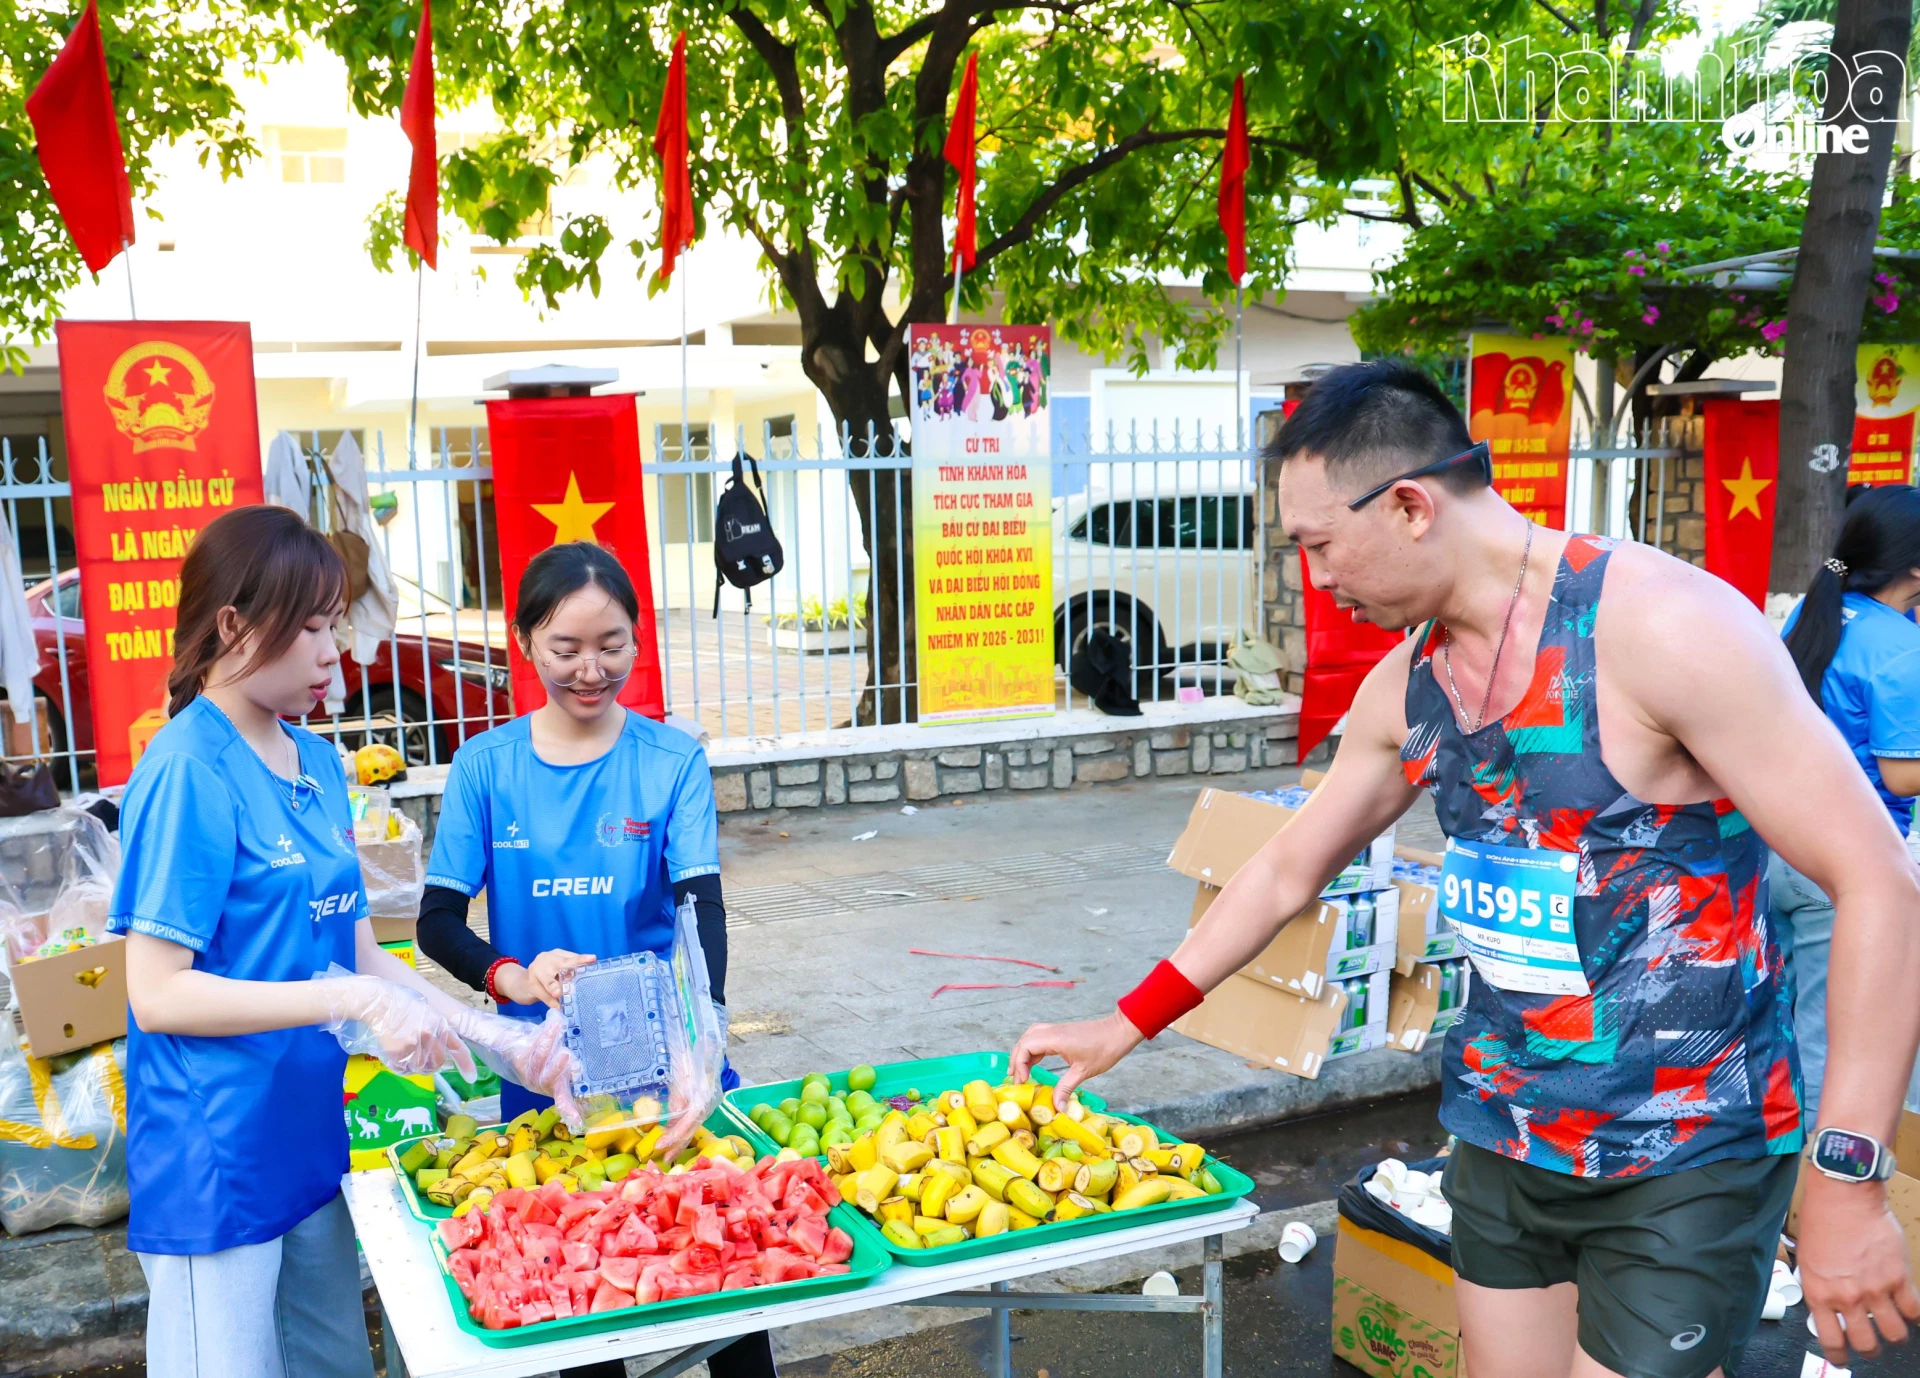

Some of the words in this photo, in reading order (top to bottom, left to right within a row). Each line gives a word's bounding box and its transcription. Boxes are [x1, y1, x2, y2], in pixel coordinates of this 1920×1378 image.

[966, 432, 980, 453] CỬ
[982, 438, 1000, 453] TRI
[939, 461, 964, 482] TỈNH
[967, 462, 1003, 481] KHÁNH
[102, 476, 158, 513] NGÀY
[162, 468, 204, 509] BẦU
[208, 469, 235, 507] CỬ
[934, 491, 957, 510] TÍCH
[960, 493, 980, 512] CỰC
[983, 493, 1013, 509] THAM
[1016, 492, 1033, 508] GIA
[942, 515, 963, 538] BẦU
[966, 516, 980, 537] CỬ
[982, 521, 1000, 539] ĐẠI
[1003, 513, 1026, 536] BIỂU
[111, 527, 139, 562] LÀ
[936, 544, 963, 569] QUỐC
[965, 546, 983, 568] HỘI
[1016, 547, 1033, 562] XVI
[929, 576, 943, 594] VÀ
[946, 578, 963, 596] ĐẠI
[966, 570, 990, 592] BIỂU
[993, 573, 1010, 594] HỘI
[1013, 570, 1040, 590] ĐỒNG
[108, 581, 146, 615] ĐẠI
[936, 602, 967, 622] NHÂN
[969, 601, 991, 620] DÂN
[994, 600, 1013, 618] CÁC
[1015, 597, 1035, 617] CẤP
[105, 625, 163, 661] TOÀN
[928, 630, 963, 652] NHIỆM
[982, 630, 1007, 647] 2026
[1016, 628, 1044, 645] 2031!
[425, 874, 472, 893] PIONSHIP
[532, 876, 614, 898] CREW
[1444, 873, 1543, 928] 91595
[1555, 902, 1563, 914] C
[132, 917, 204, 949] HAMPIONSHIP
[1486, 936, 1501, 945] KUPO
[1425, 940, 1452, 957] ZION
[1337, 956, 1365, 975] ZION
[1369, 1339, 1397, 1362] BANG
